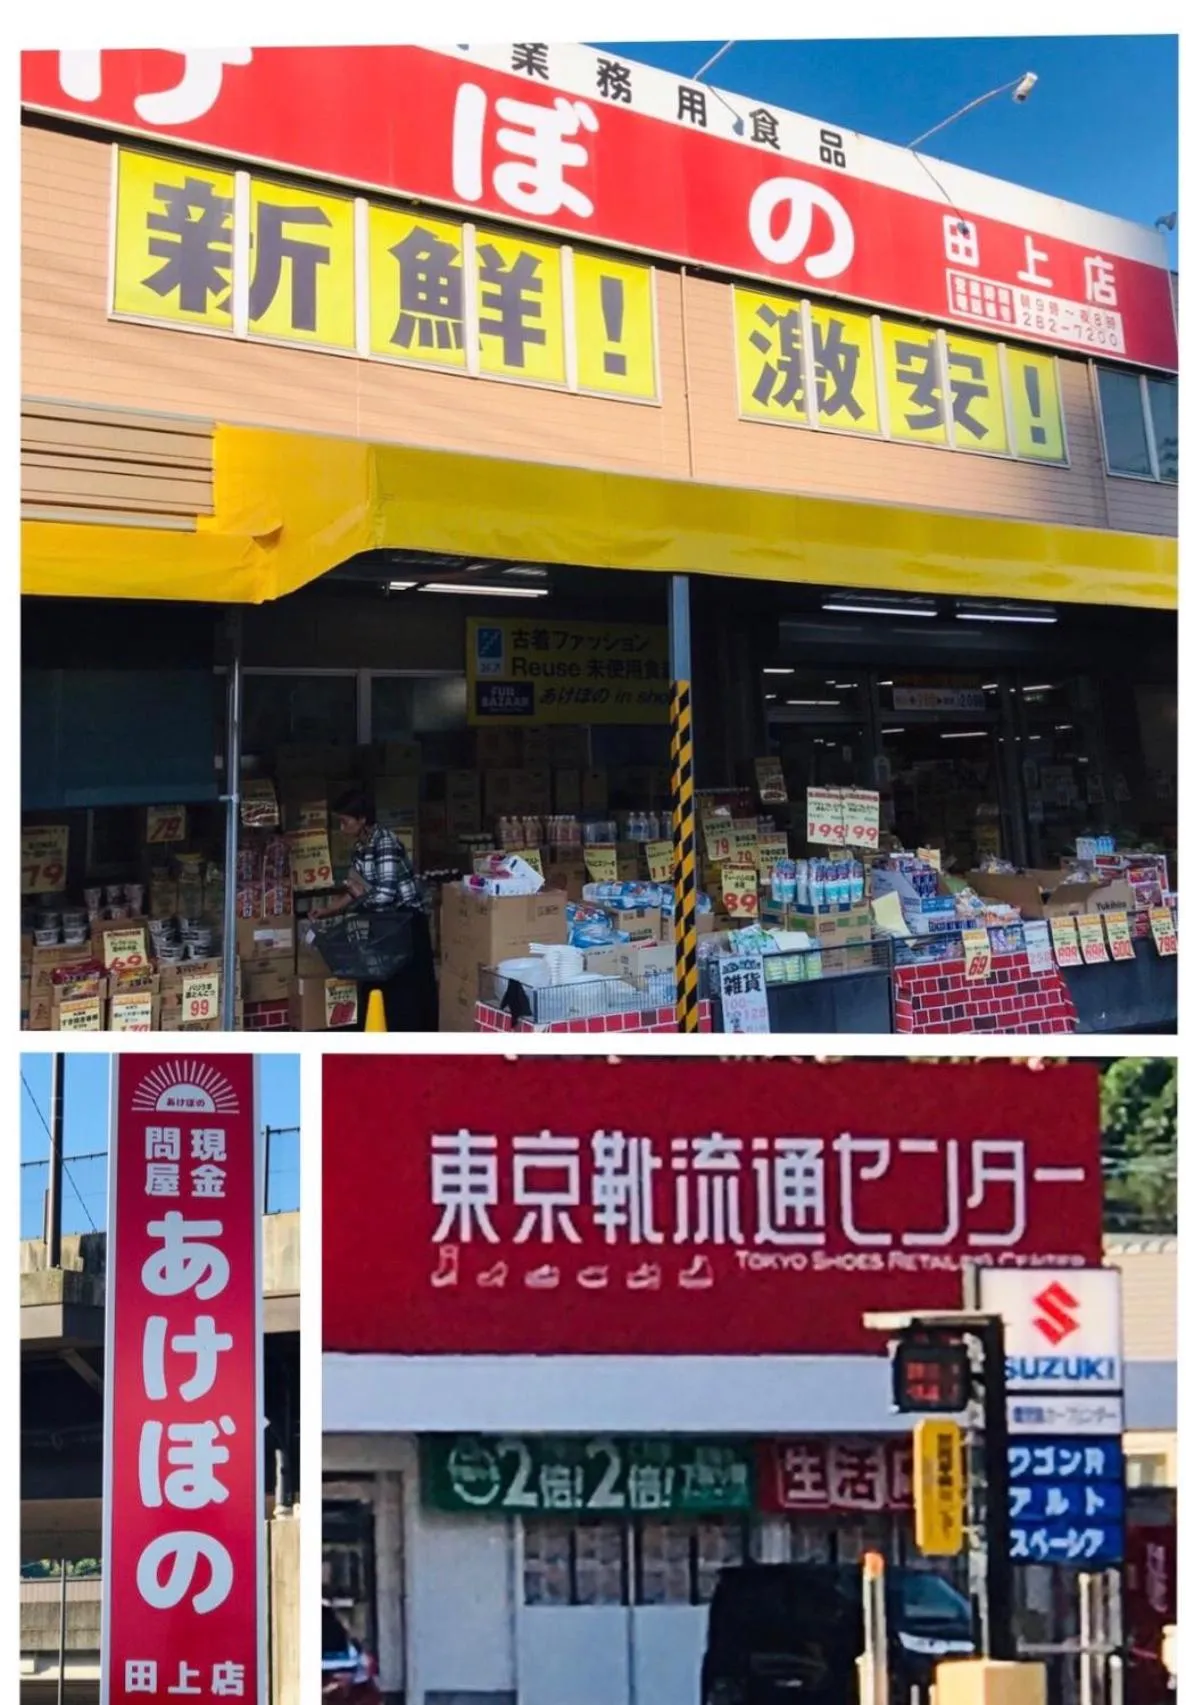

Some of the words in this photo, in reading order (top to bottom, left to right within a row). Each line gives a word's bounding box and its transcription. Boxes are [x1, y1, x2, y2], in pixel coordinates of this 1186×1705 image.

[511, 43, 846, 168] 業務用食品
[943, 214, 1118, 307] 田上店
[511, 628, 650, 652] 古着ファッション
[512, 657, 581, 678] Reuse
[22, 863, 63, 887] 79
[293, 866, 330, 886] 139
[724, 893, 757, 913] 89
[969, 956, 988, 976] 69
[724, 972, 762, 996] 雑貨
[191, 1000, 209, 1017] 99
[145, 1125, 181, 1197] 問屋
[190, 1128, 227, 1198] 現金
[430, 1128, 1086, 1247] 東京靴流通センター
[739, 1251, 807, 1271] TOKYO
[812, 1251, 885, 1272] SHOES
[1005, 1356, 1115, 1381] SUZUKI
[136, 1211, 234, 1614] あけぼの
[785, 1446, 911, 1502] 生活
[1008, 1485, 1105, 1518] アルト
[125, 1660, 245, 1696] 田上店
